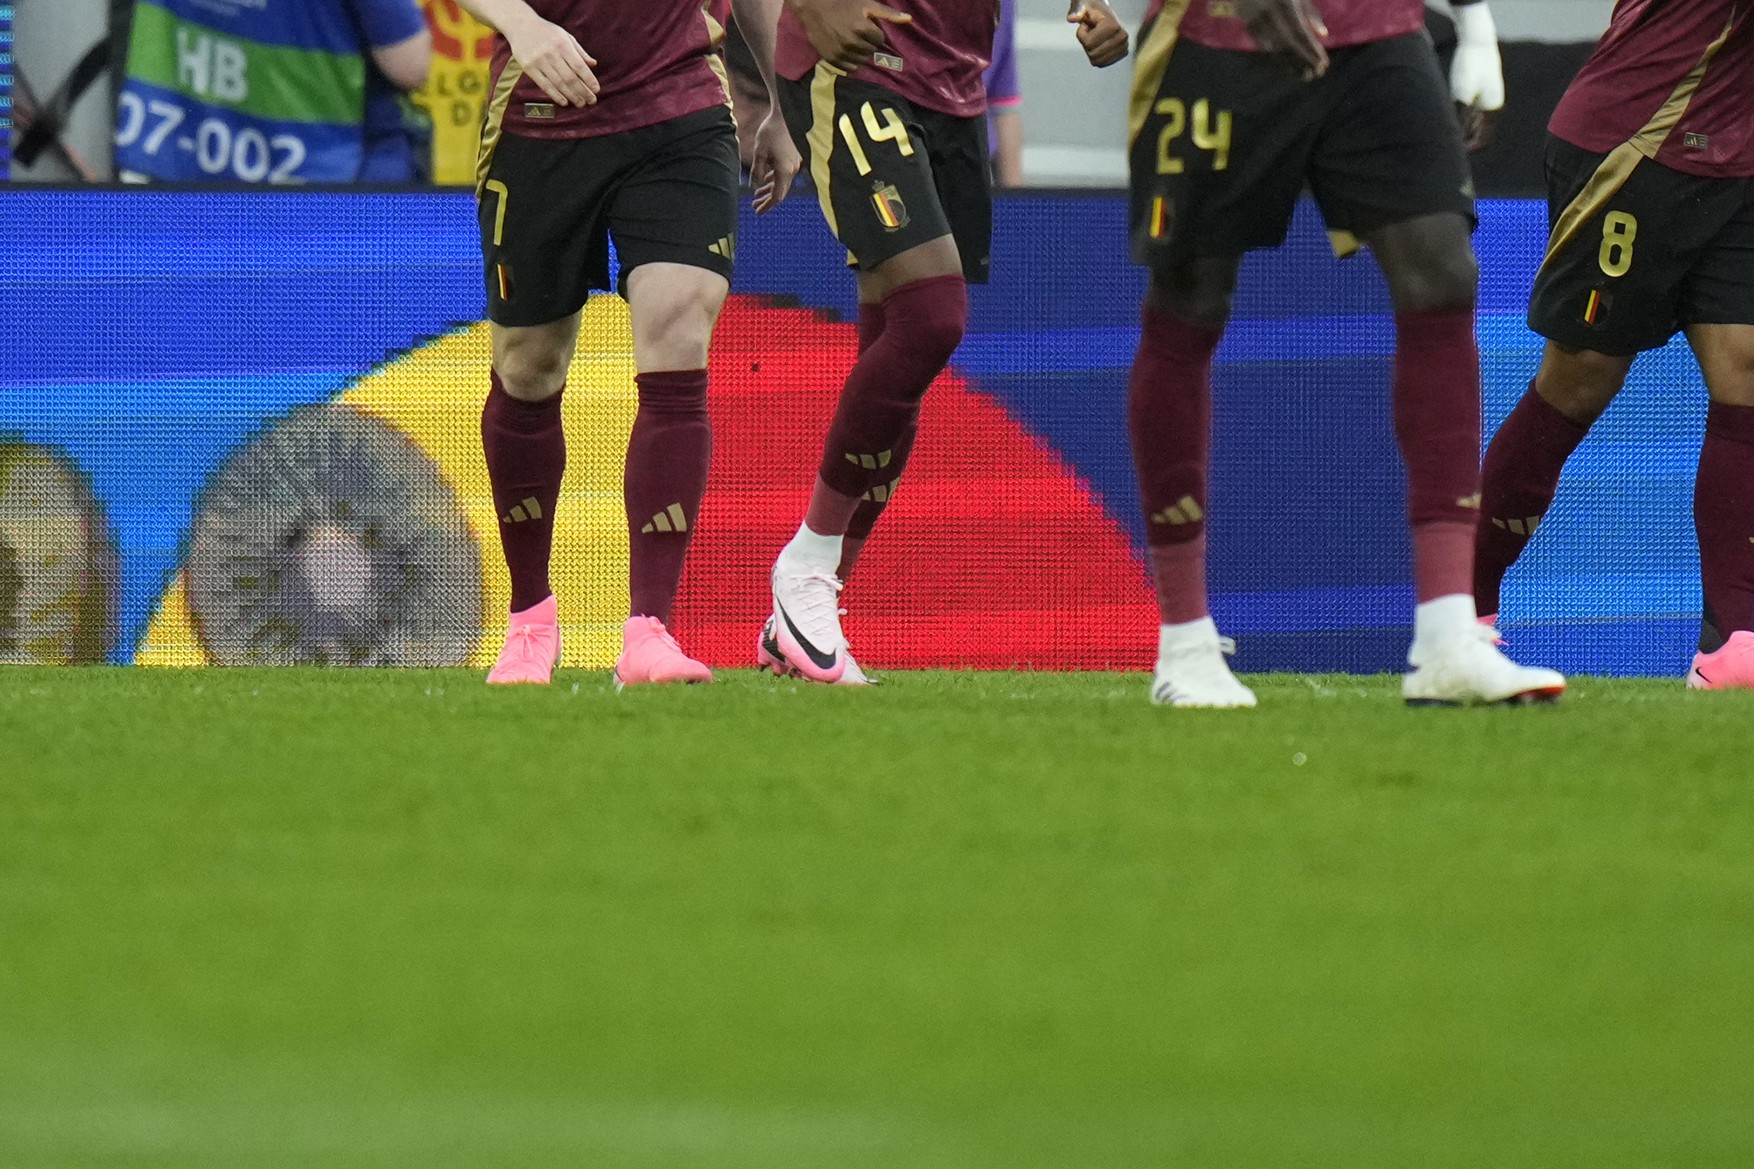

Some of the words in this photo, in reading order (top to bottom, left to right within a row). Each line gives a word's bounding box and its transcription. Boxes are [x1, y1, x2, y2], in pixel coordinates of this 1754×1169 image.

[175, 26, 249, 101] HB
[838, 100, 915, 177] 14
[1154, 96, 1233, 175] 24
[486, 178, 508, 246] 7
[1598, 210, 1638, 278] 8
